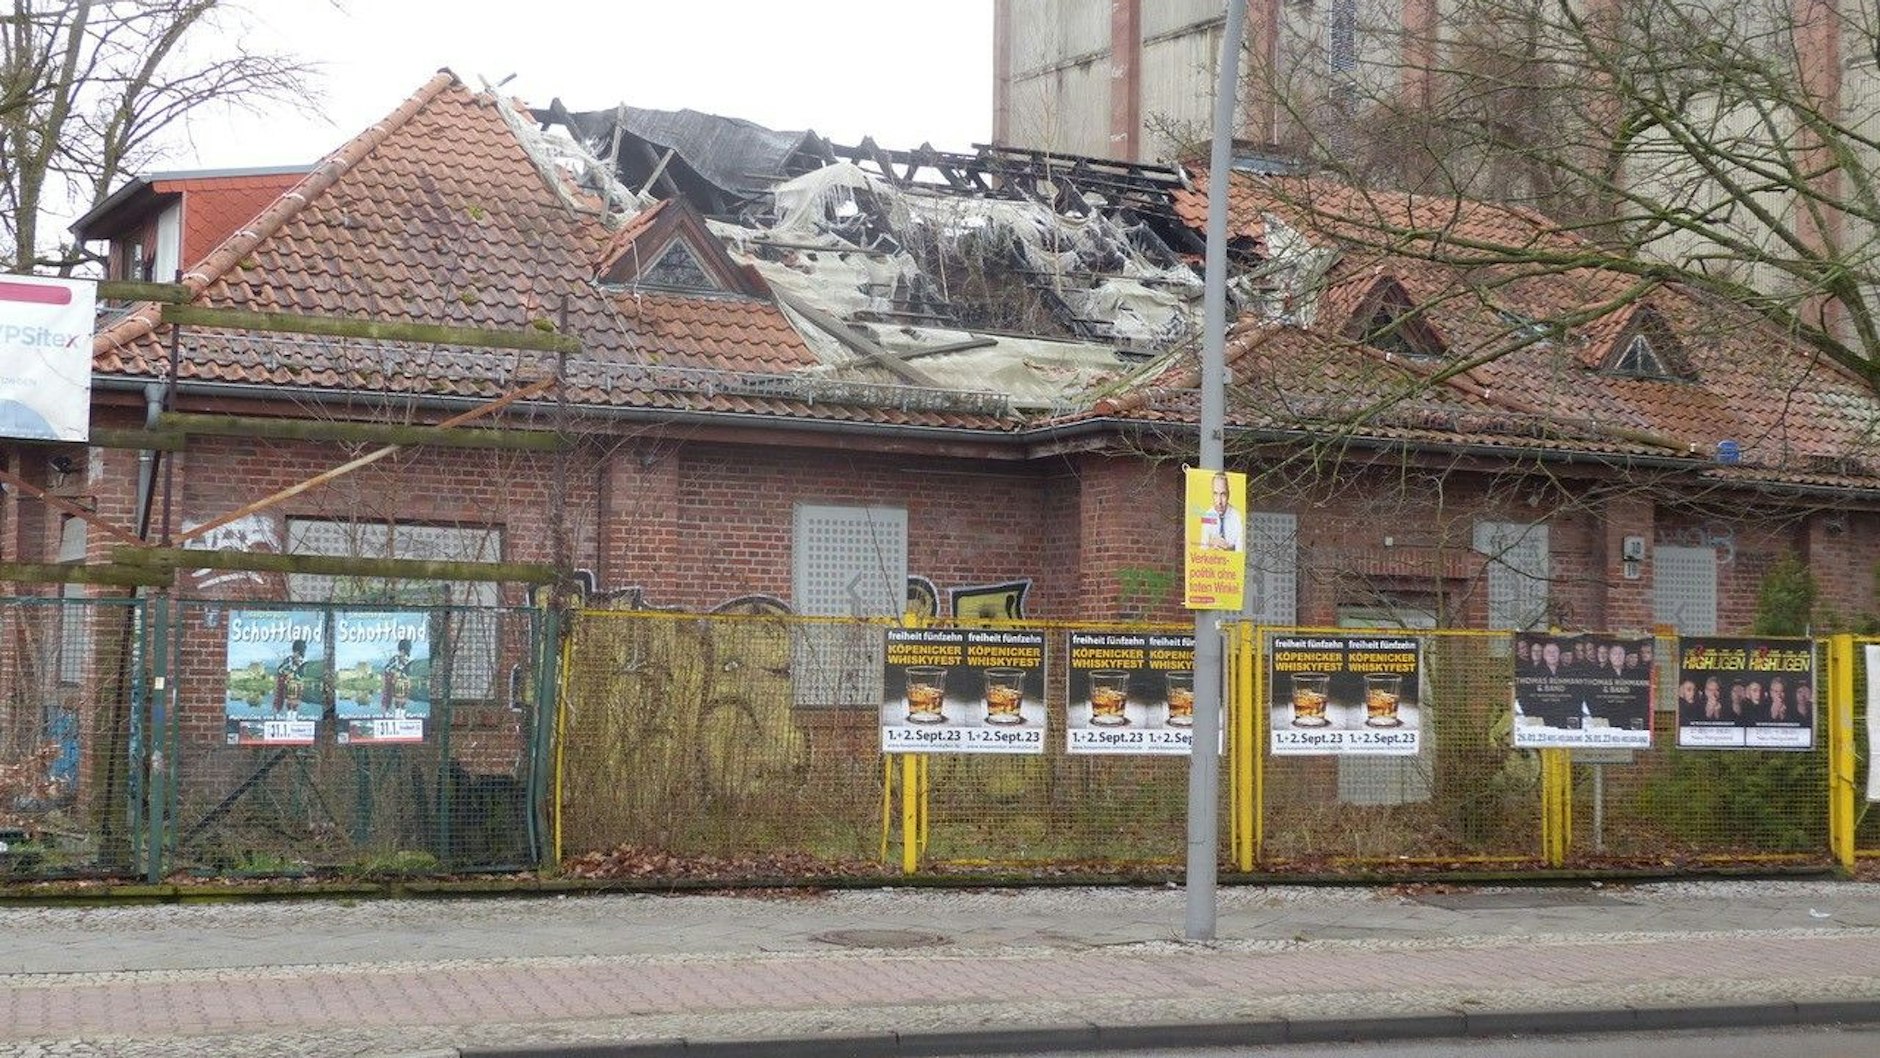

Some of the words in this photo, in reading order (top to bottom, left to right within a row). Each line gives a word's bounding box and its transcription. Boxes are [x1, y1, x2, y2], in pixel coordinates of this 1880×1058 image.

[232, 618, 323, 643] Schottland
[338, 618, 427, 643] Schottland
[888, 631, 922, 641] freiheit
[923, 632, 963, 642] fünfzehn
[968, 632, 1001, 642] freiheit
[1002, 633, 1042, 644] fünfzehn
[1072, 635, 1105, 645] freiheit
[1106, 636, 1145, 646] fünfzehn
[1149, 636, 1181, 646] freiheit
[888, 643, 962, 655] KÖPENICKER
[1275, 639, 1307, 648] freiheit
[1308, 639, 1343, 649] fünfzehn
[1349, 640, 1379, 649] freiheit
[1380, 640, 1416, 650] fünfzehn
[968, 645, 1041, 656] KÖPENICKER
[1072, 648, 1144, 659] KÖPENICKER
[887, 655, 962, 665] WHISKYFEST
[967, 656, 1041, 667] WHISKYFEST
[1275, 651, 1343, 662] KÖPENICKER
[1349, 652, 1416, 662] KÖPENICKER
[1072, 659, 1144, 669] WHISKYFEST
[1275, 662, 1343, 672] WHISKYFEST
[1348, 662, 1416, 672] WHISKYFEST
